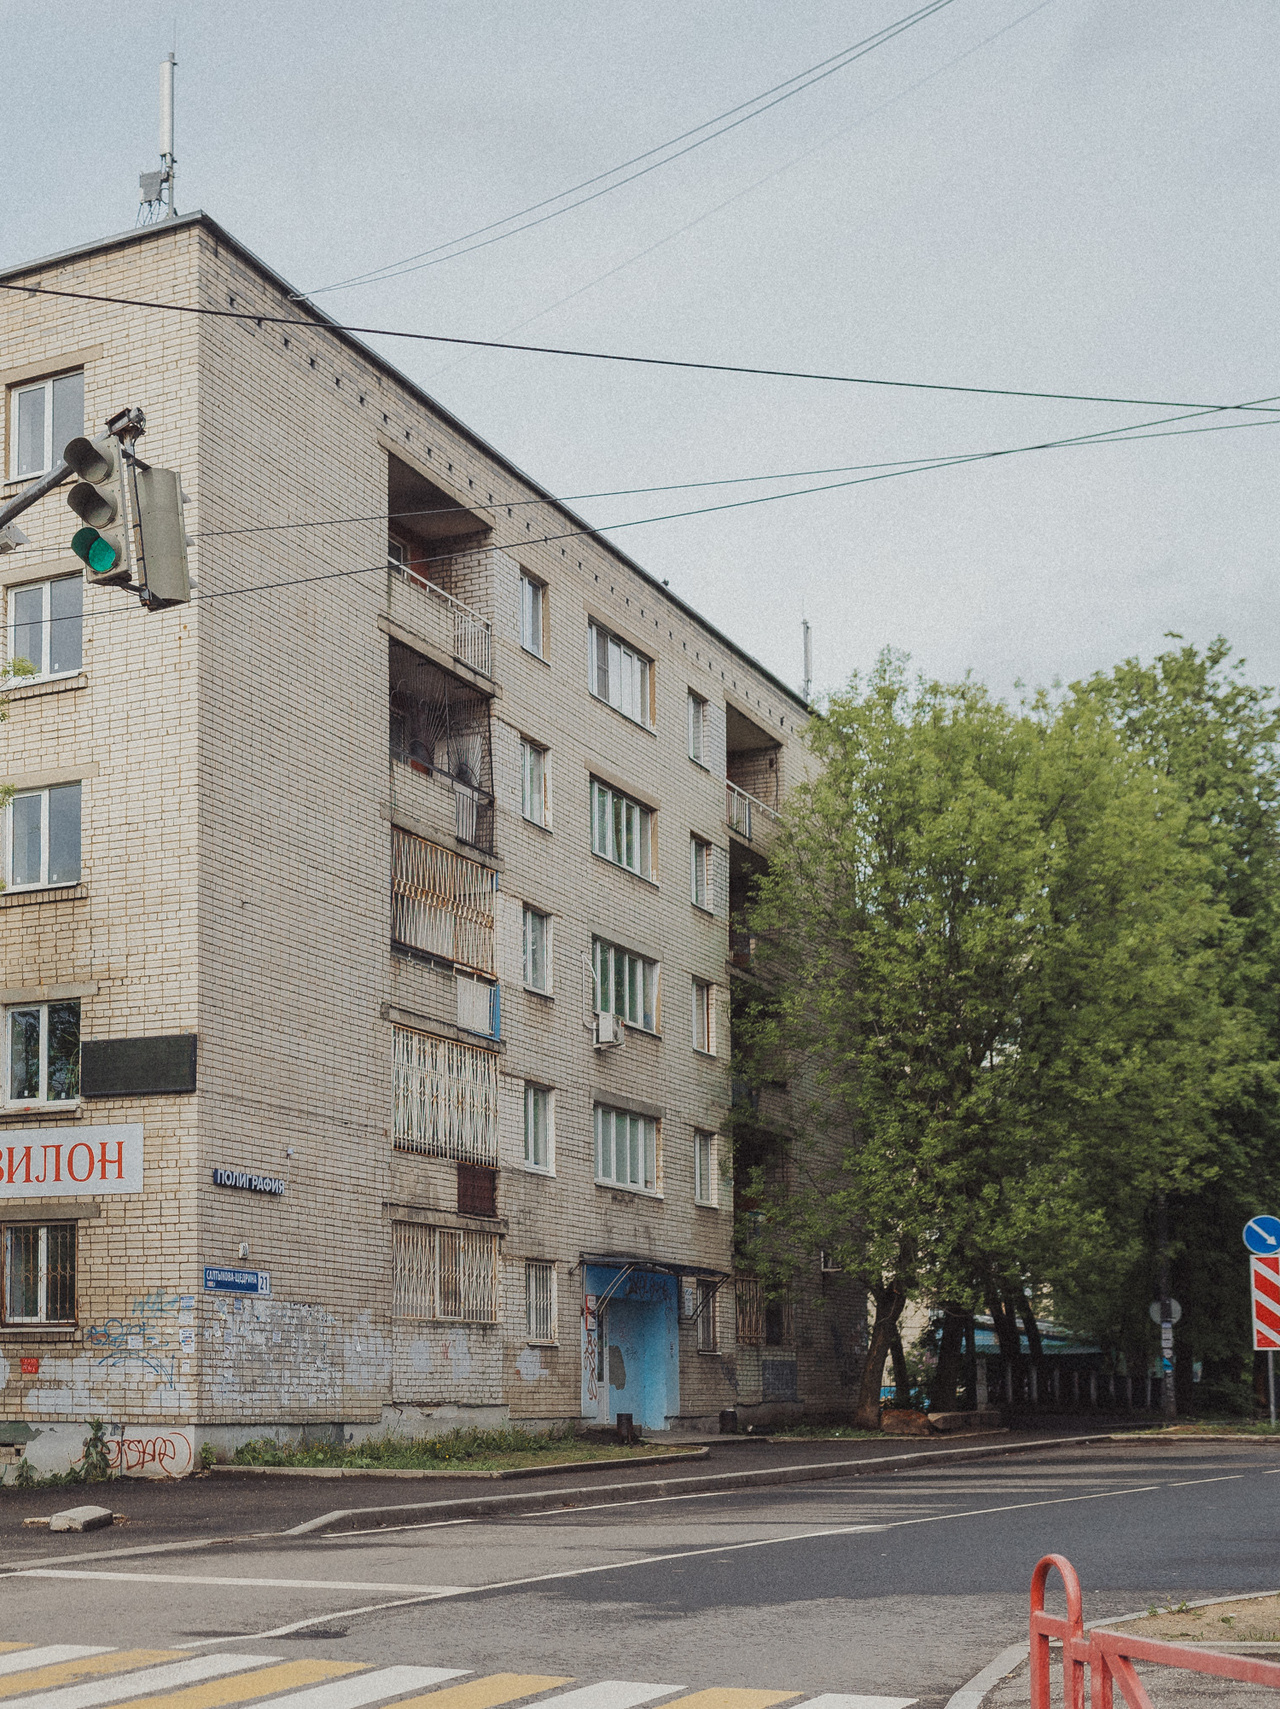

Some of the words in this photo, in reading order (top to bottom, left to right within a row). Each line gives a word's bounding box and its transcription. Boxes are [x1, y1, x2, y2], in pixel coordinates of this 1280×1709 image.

[216, 1169, 285, 1195] ПОЛИГРАФИЯ
[206, 1269, 257, 1284] САЛТЫКОВА-ЩЕДРИНА
[259, 1275, 269, 1291] 21
